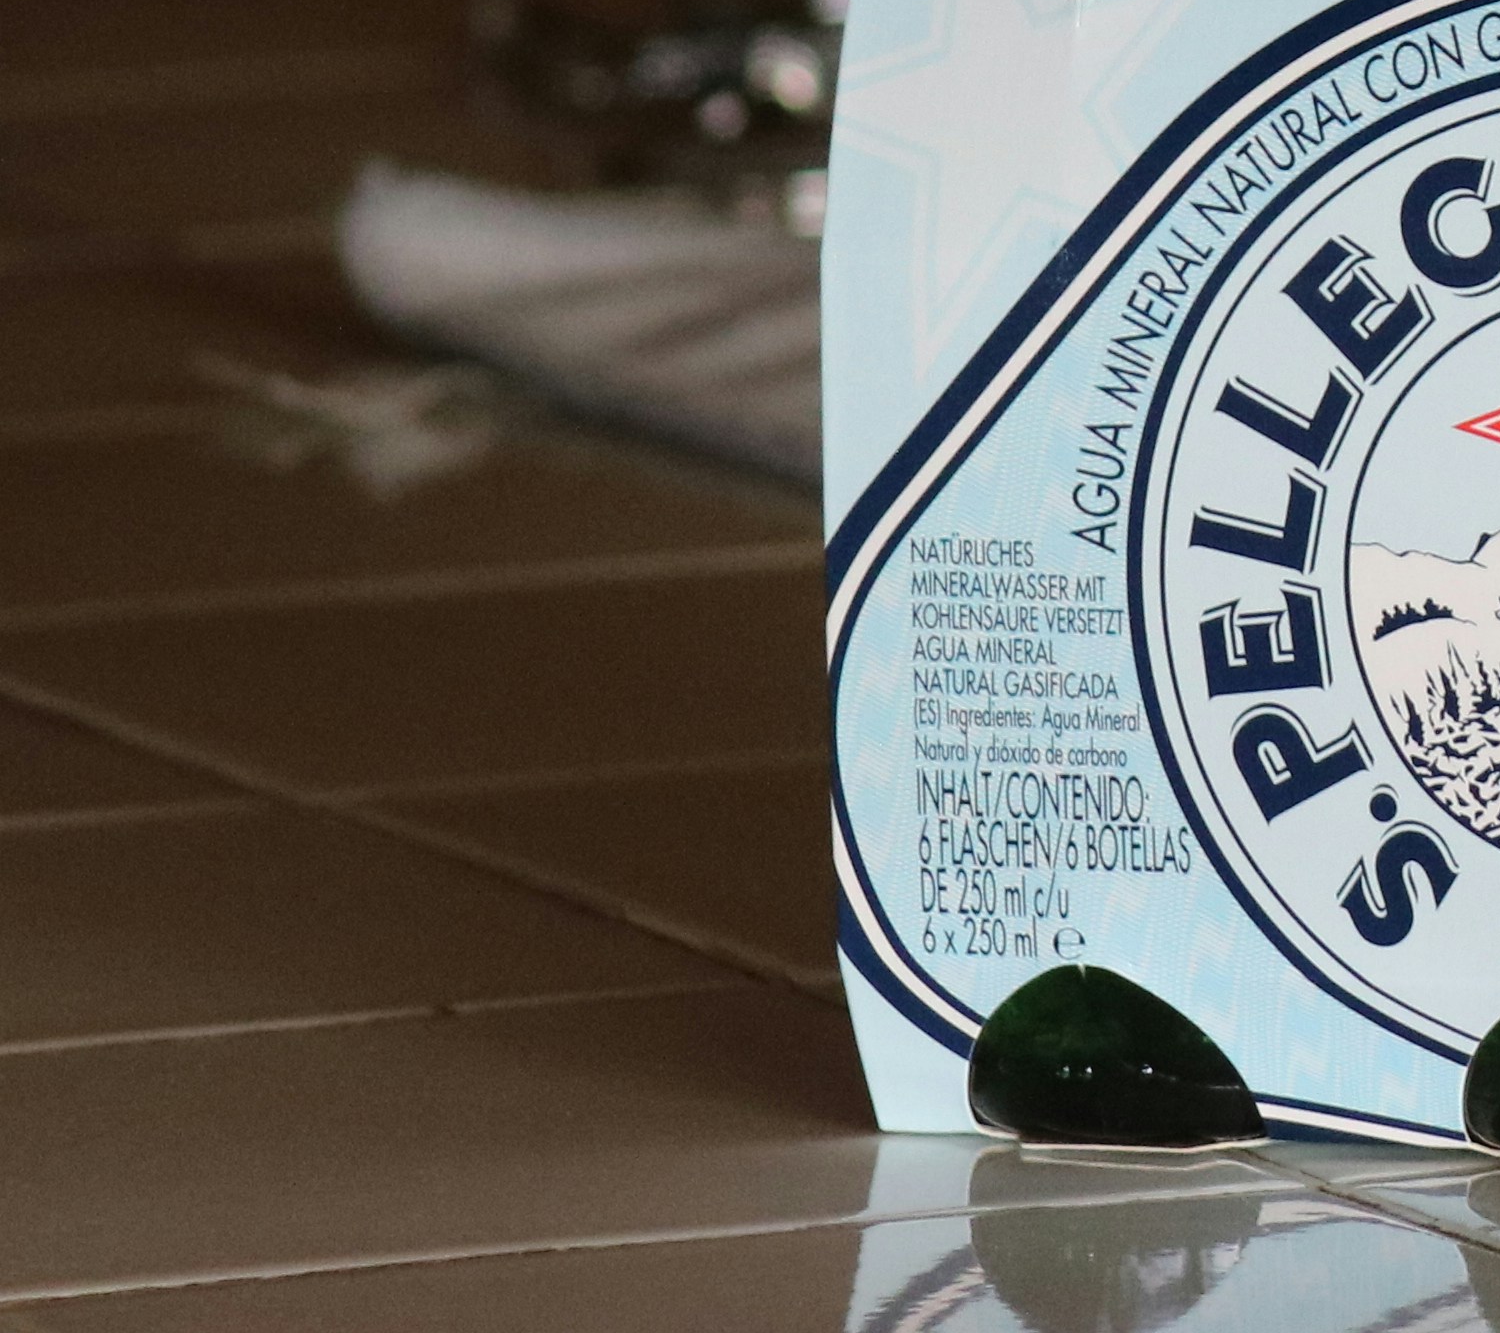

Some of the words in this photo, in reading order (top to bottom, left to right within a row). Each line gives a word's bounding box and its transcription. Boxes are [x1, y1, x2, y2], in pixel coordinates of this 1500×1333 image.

[1363, 23, 1465, 104] CON
[1190, 78, 1362, 236] NATURAL
[1100, 227, 1214, 412] MINERAL
[1071, 421, 1134, 554] AGUA
[910, 532, 1034, 567] NATÜRLICHES
[911, 571, 1068, 601] MINERALWASSER
[1075, 576, 1106, 601] MIT
[912, 599, 1039, 633] KOHLENSÄURE
[1044, 609, 1124, 635] VERSETZT
[913, 636, 970, 662] AGUA
[976, 638, 1057, 665] MINERAL
[913, 668, 999, 696] NATURAL
[1004, 671, 1119, 699] GASIFICADA
[914, 699, 941, 729] (ES)
[946, 698, 1036, 733] Ingredientes:
[1042, 709, 1081, 737] Agua
[1085, 703, 1141, 731] Mineral
[915, 735, 969, 761] Natural
[974, 744, 981, 763] y
[987, 734, 1040, 764] dióxido
[1046, 737, 1063, 765] de
[1068, 737, 1127, 767] carbono
[919, 819, 932, 865] 6
[1086, 824, 1192, 873] BOTELLAS
[920, 868, 950, 913] DE
[956, 868, 997, 915] 250
[1004, 875, 1027, 917] ml
[1034, 872, 1069, 919] c/u
[923, 917, 936, 953] 6
[945, 930, 957, 955] x
[964, 917, 1006, 956] 250
[1015, 916, 1038, 958] ml
